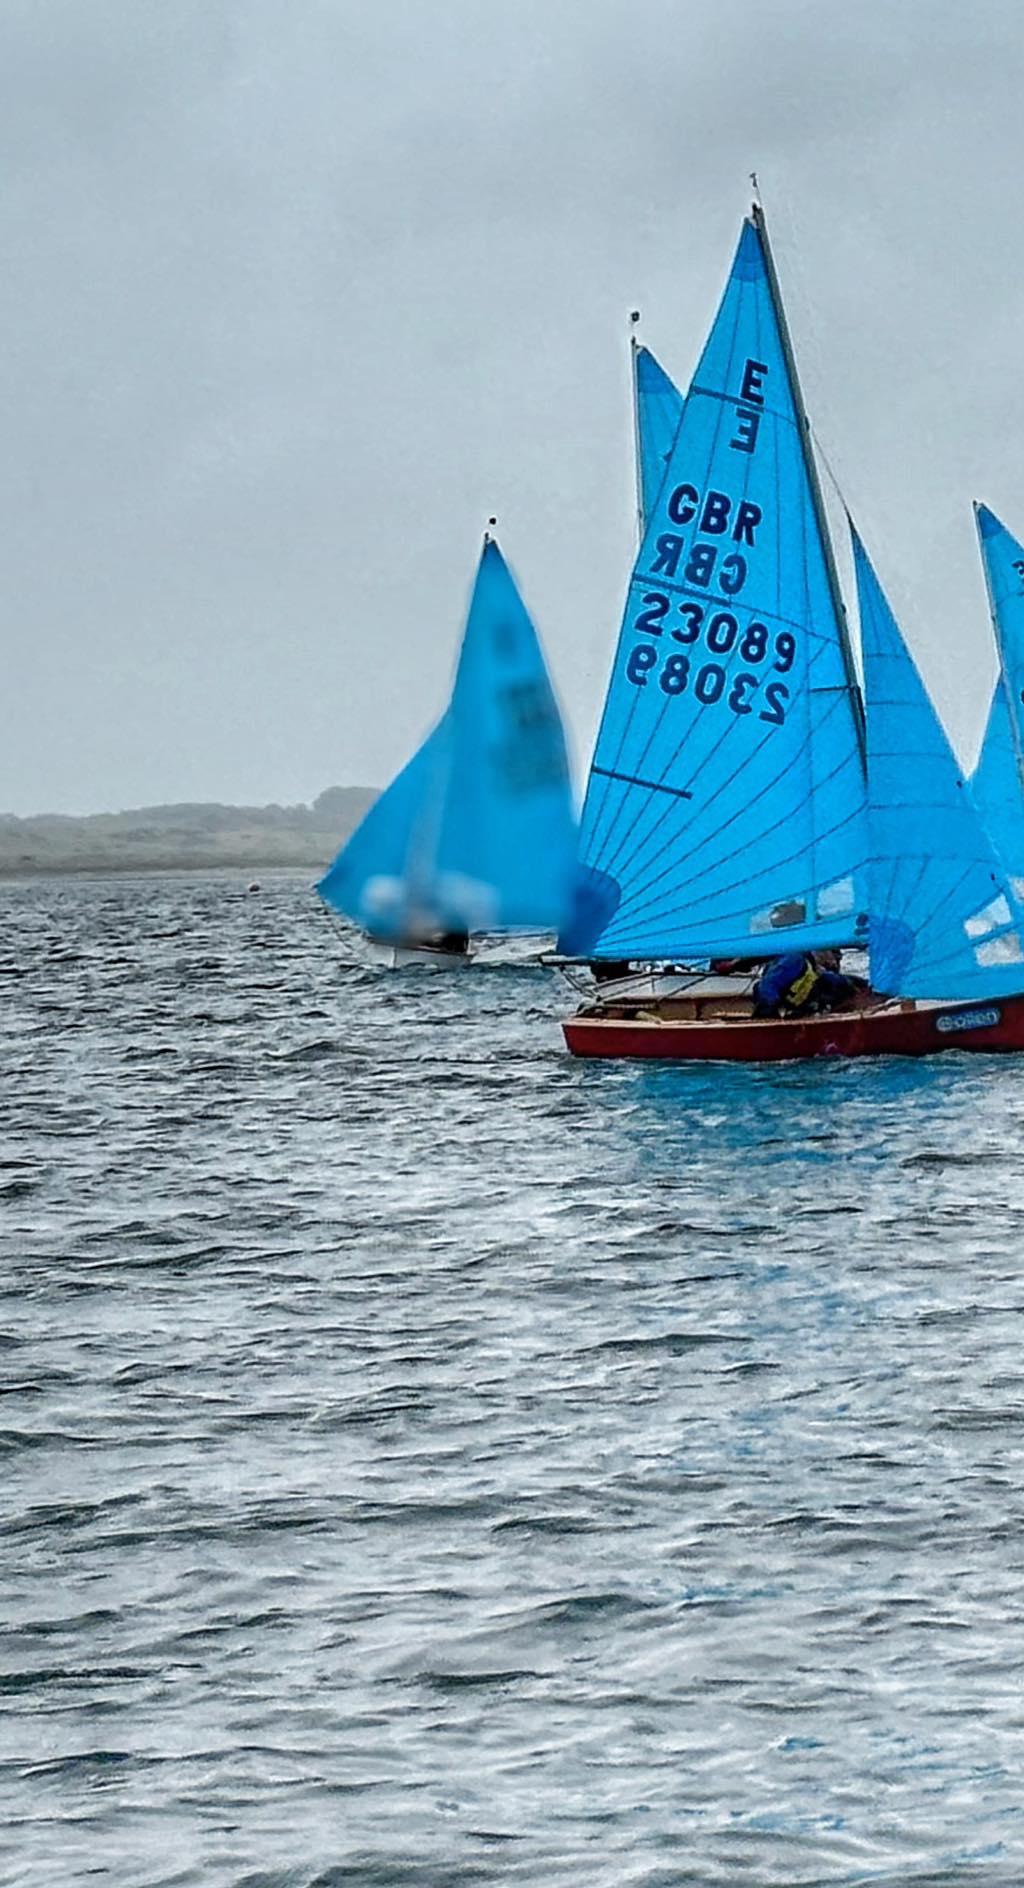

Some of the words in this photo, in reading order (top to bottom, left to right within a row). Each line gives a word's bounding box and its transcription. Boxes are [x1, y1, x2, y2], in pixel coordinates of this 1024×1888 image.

[740, 358, 768, 404] E
[668, 483, 762, 548] GBR
[634, 592, 796, 673] 23089
